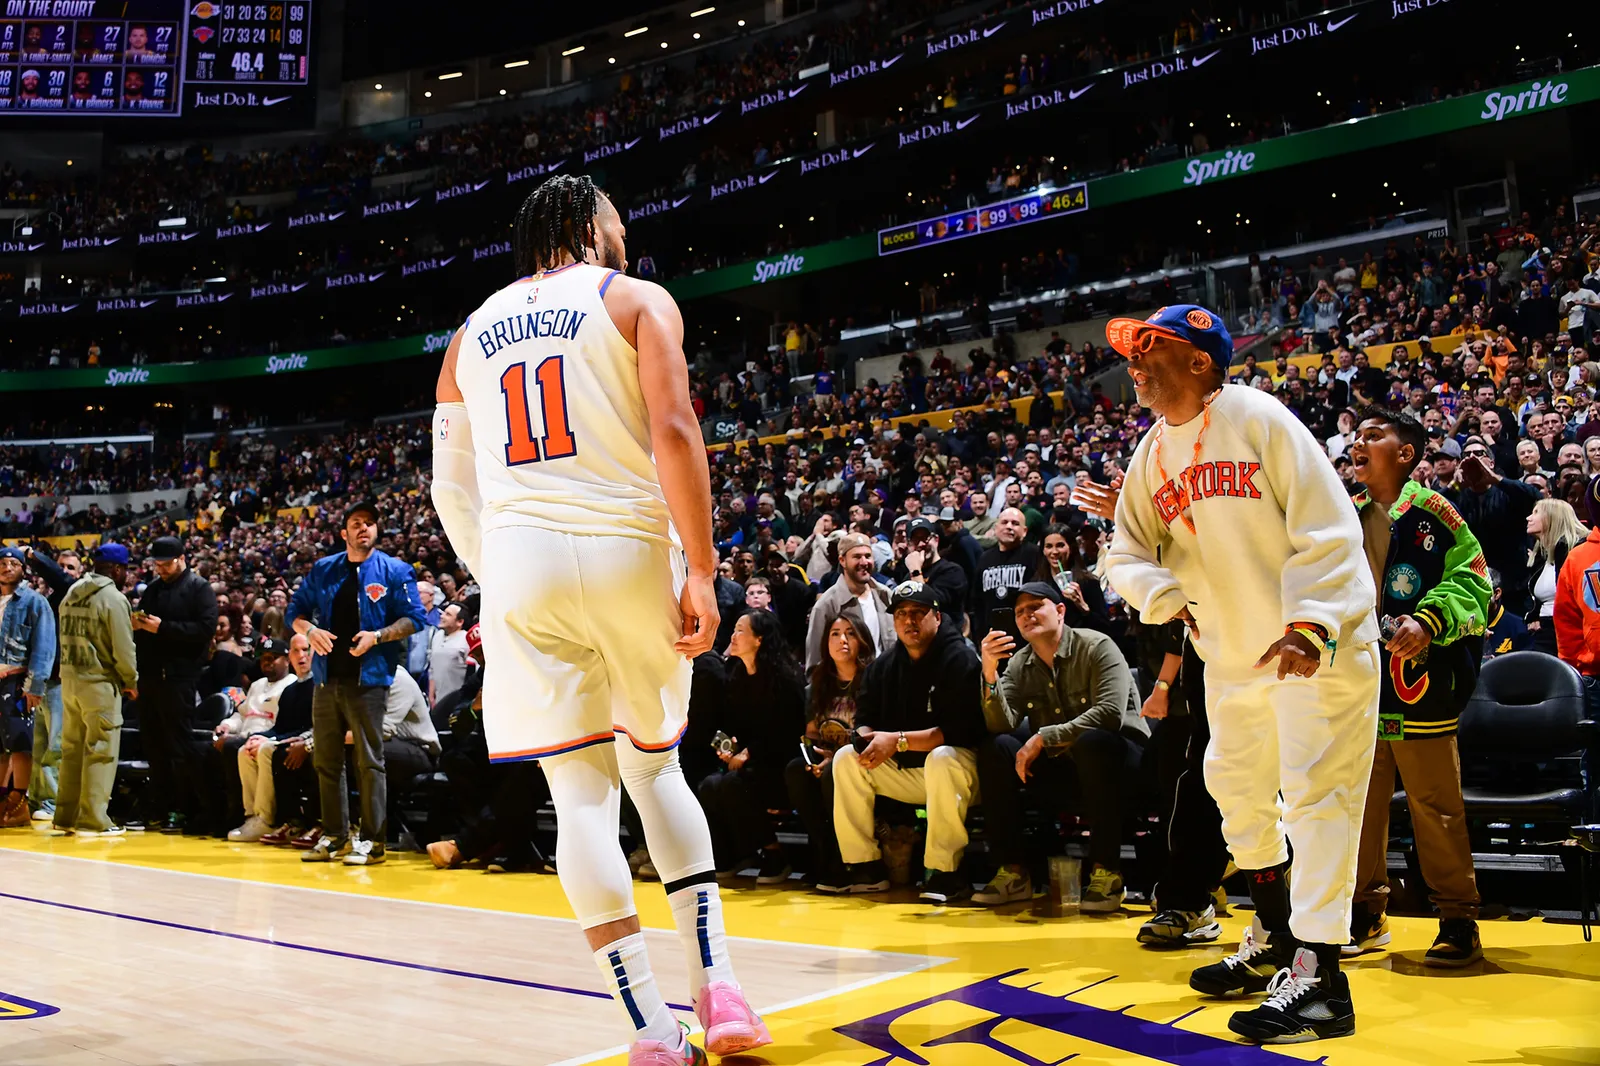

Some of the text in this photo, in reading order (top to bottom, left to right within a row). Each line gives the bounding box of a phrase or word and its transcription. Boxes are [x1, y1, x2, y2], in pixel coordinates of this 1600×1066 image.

[6, 0, 96, 16] ON THE COURT
[224, 5, 304, 21] 31 20 25 23 99
[1032, 6, 1055, 26] Just
[1057, 1, 1078, 16] Do
[4, 25, 14, 40] 6
[56, 26, 65, 41] 2
[104, 26, 120, 42] 27
[156, 27, 172, 42] 27
[222, 28, 303, 44] 27 33 24 14 98
[1252, 32, 1280, 55] Just
[1282, 26, 1307, 44] Do
[926, 40, 948, 58] Just
[950, 34, 969, 48] Do
[232, 52, 264, 72] 46.4
[48, 70, 66, 86] 30
[104, 71, 113, 86] 6
[154, 72, 168, 87] 12
[830, 70, 850, 88] Just
[851, 65, 868, 78] Do
[1123, 68, 1150, 88] Just
[1151, 61, 1174, 78] Do
[194, 92, 220, 108] Just
[223, 92, 246, 106] Do
[741, 99, 759, 116] Just
[761, 94, 777, 106] Do
[1006, 100, 1030, 120] Just
[1031, 94, 1052, 110] Do
[1481, 80, 1568, 120] Sprite
[659, 125, 676, 140] Just
[677, 120, 692, 132] Do
[898, 129, 920, 148] Just
[922, 124, 942, 139] Do
[584, 150, 599, 165] Just
[600, 146, 614, 158] Do
[800, 158, 820, 176] Just
[822, 152, 840, 166] Do
[506, 169, 522, 184] Just
[524, 166, 538, 178] Do
[1183, 150, 1256, 186] Sprite
[436, 188, 450, 203] Just
[451, 185, 464, 197] Do
[710, 183, 728, 200] Just
[730, 178, 746, 192] Do
[363, 203, 378, 218] Just
[380, 202, 394, 213] Do
[628, 207, 644, 222] Just
[646, 203, 661, 216] Do
[883, 231, 915, 246] BLOCKS
[925, 226, 934, 238] 4
[956, 219, 964, 232] 2
[989, 209, 1007, 224] 99
[1020, 202, 1038, 218] 98
[1052, 190, 1084, 210] 46.4
[288, 214, 303, 229] Just
[304, 214, 318, 224] Do
[138, 233, 156, 245] Just
[156, 232, 170, 243] Do
[216, 227, 231, 240] Just
[232, 226, 246, 236] Do
[3, 242, 18, 251] Do
[62, 238, 78, 250] Just
[79, 238, 92, 248] Do
[472, 246, 488, 262] Just
[490, 244, 504, 256] Do
[402, 262, 416, 278] Just
[418, 260, 432, 272] Do
[753, 254, 804, 283] Sprite
[326, 275, 342, 290] Just
[343, 274, 357, 284] Do
[176, 296, 192, 308] Just
[194, 294, 208, 304] Do
[251, 286, 266, 300] Just
[266, 285, 280, 296] Do
[19, 304, 36, 317] Just
[36, 304, 50, 314] Do
[96, 300, 112, 312] Just
[114, 300, 128, 310] Do
[1188, 313, 1210, 329] KNICKS
[423, 329, 456, 353] Spri
[478, 308, 587, 360] BRUNSON
[266, 353, 308, 374] Sprite
[104, 367, 150, 387] Sprite
[500, 354, 578, 466] 11
[1185, 461, 1262, 501] YORK
[1424, 498, 1462, 531] PISTONS
[1389, 566, 1417, 581] CELTICS
[1254, 871, 1276, 884] 23
